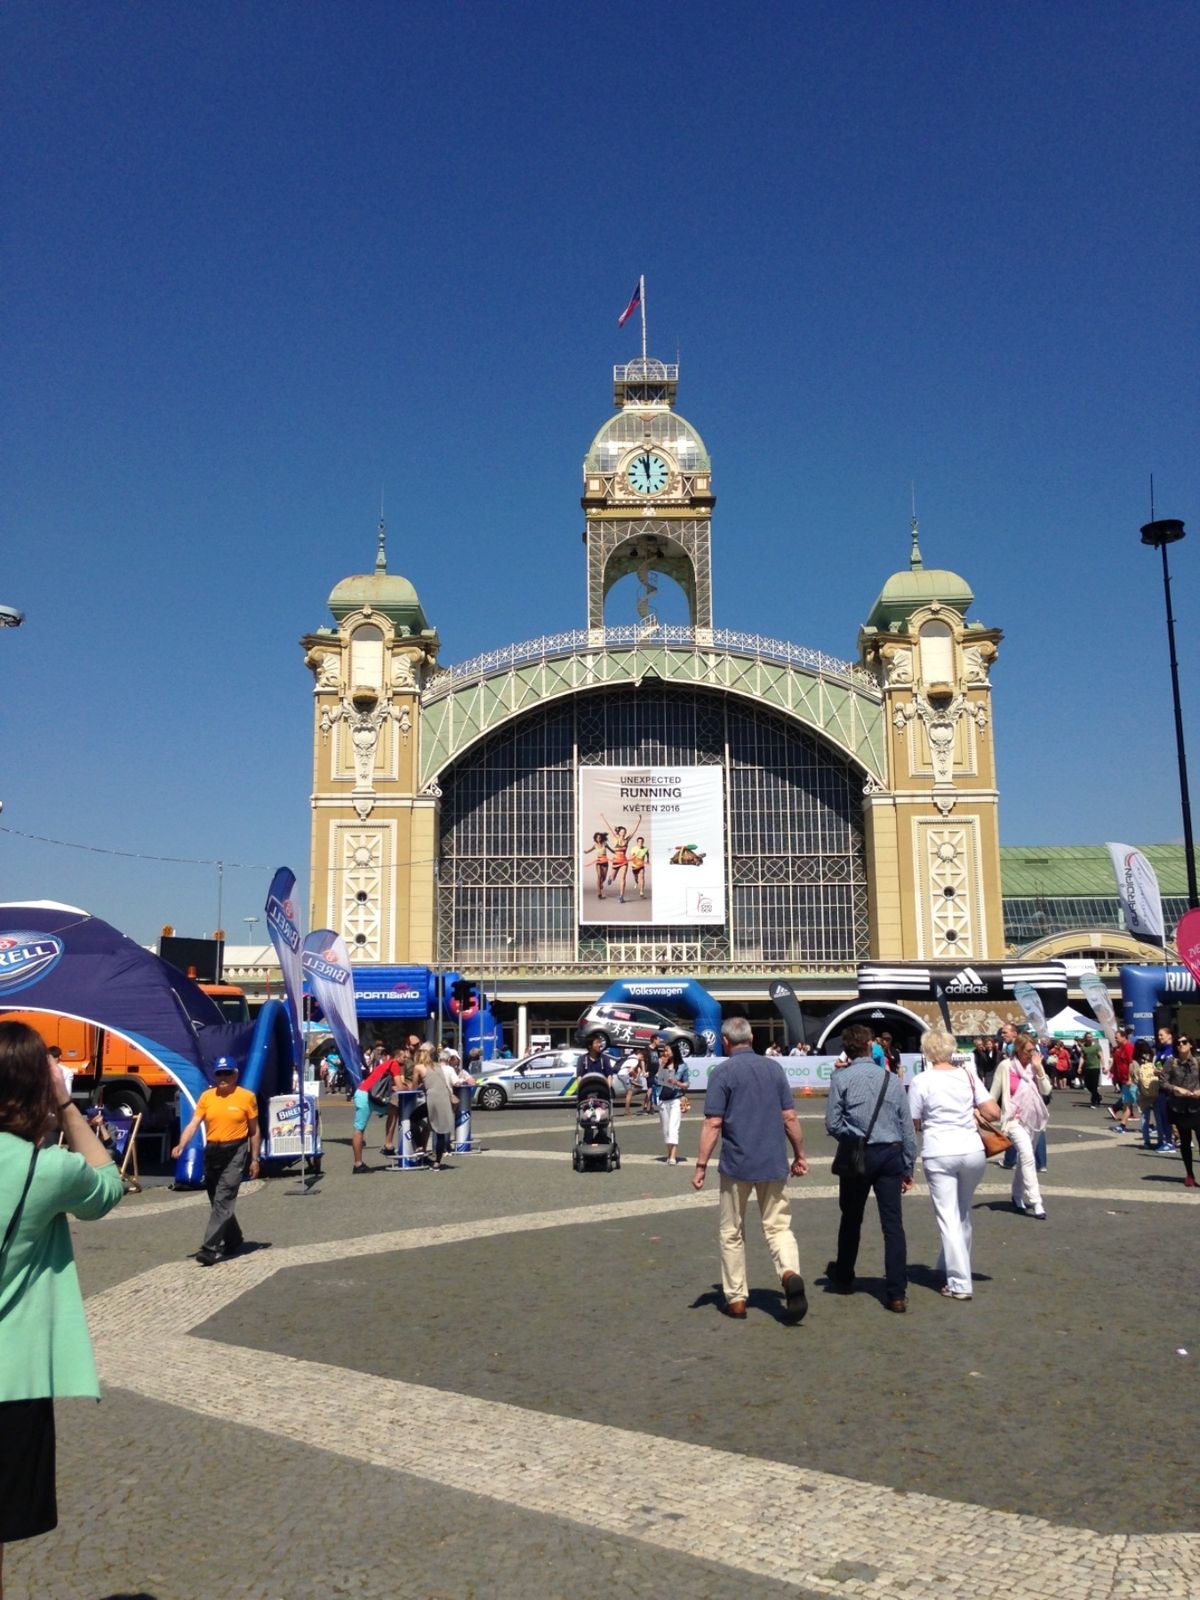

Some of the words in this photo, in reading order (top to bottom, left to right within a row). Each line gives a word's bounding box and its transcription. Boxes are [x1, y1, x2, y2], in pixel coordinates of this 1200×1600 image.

[620, 776, 682, 784] UNEXPECTED
[620, 787, 682, 798] RUNNING
[629, 987, 683, 997] Volkswagen
[945, 984, 988, 994] adidas
[354, 991, 420, 1000] PORTISIMO
[514, 1080, 551, 1090] POLICIE
